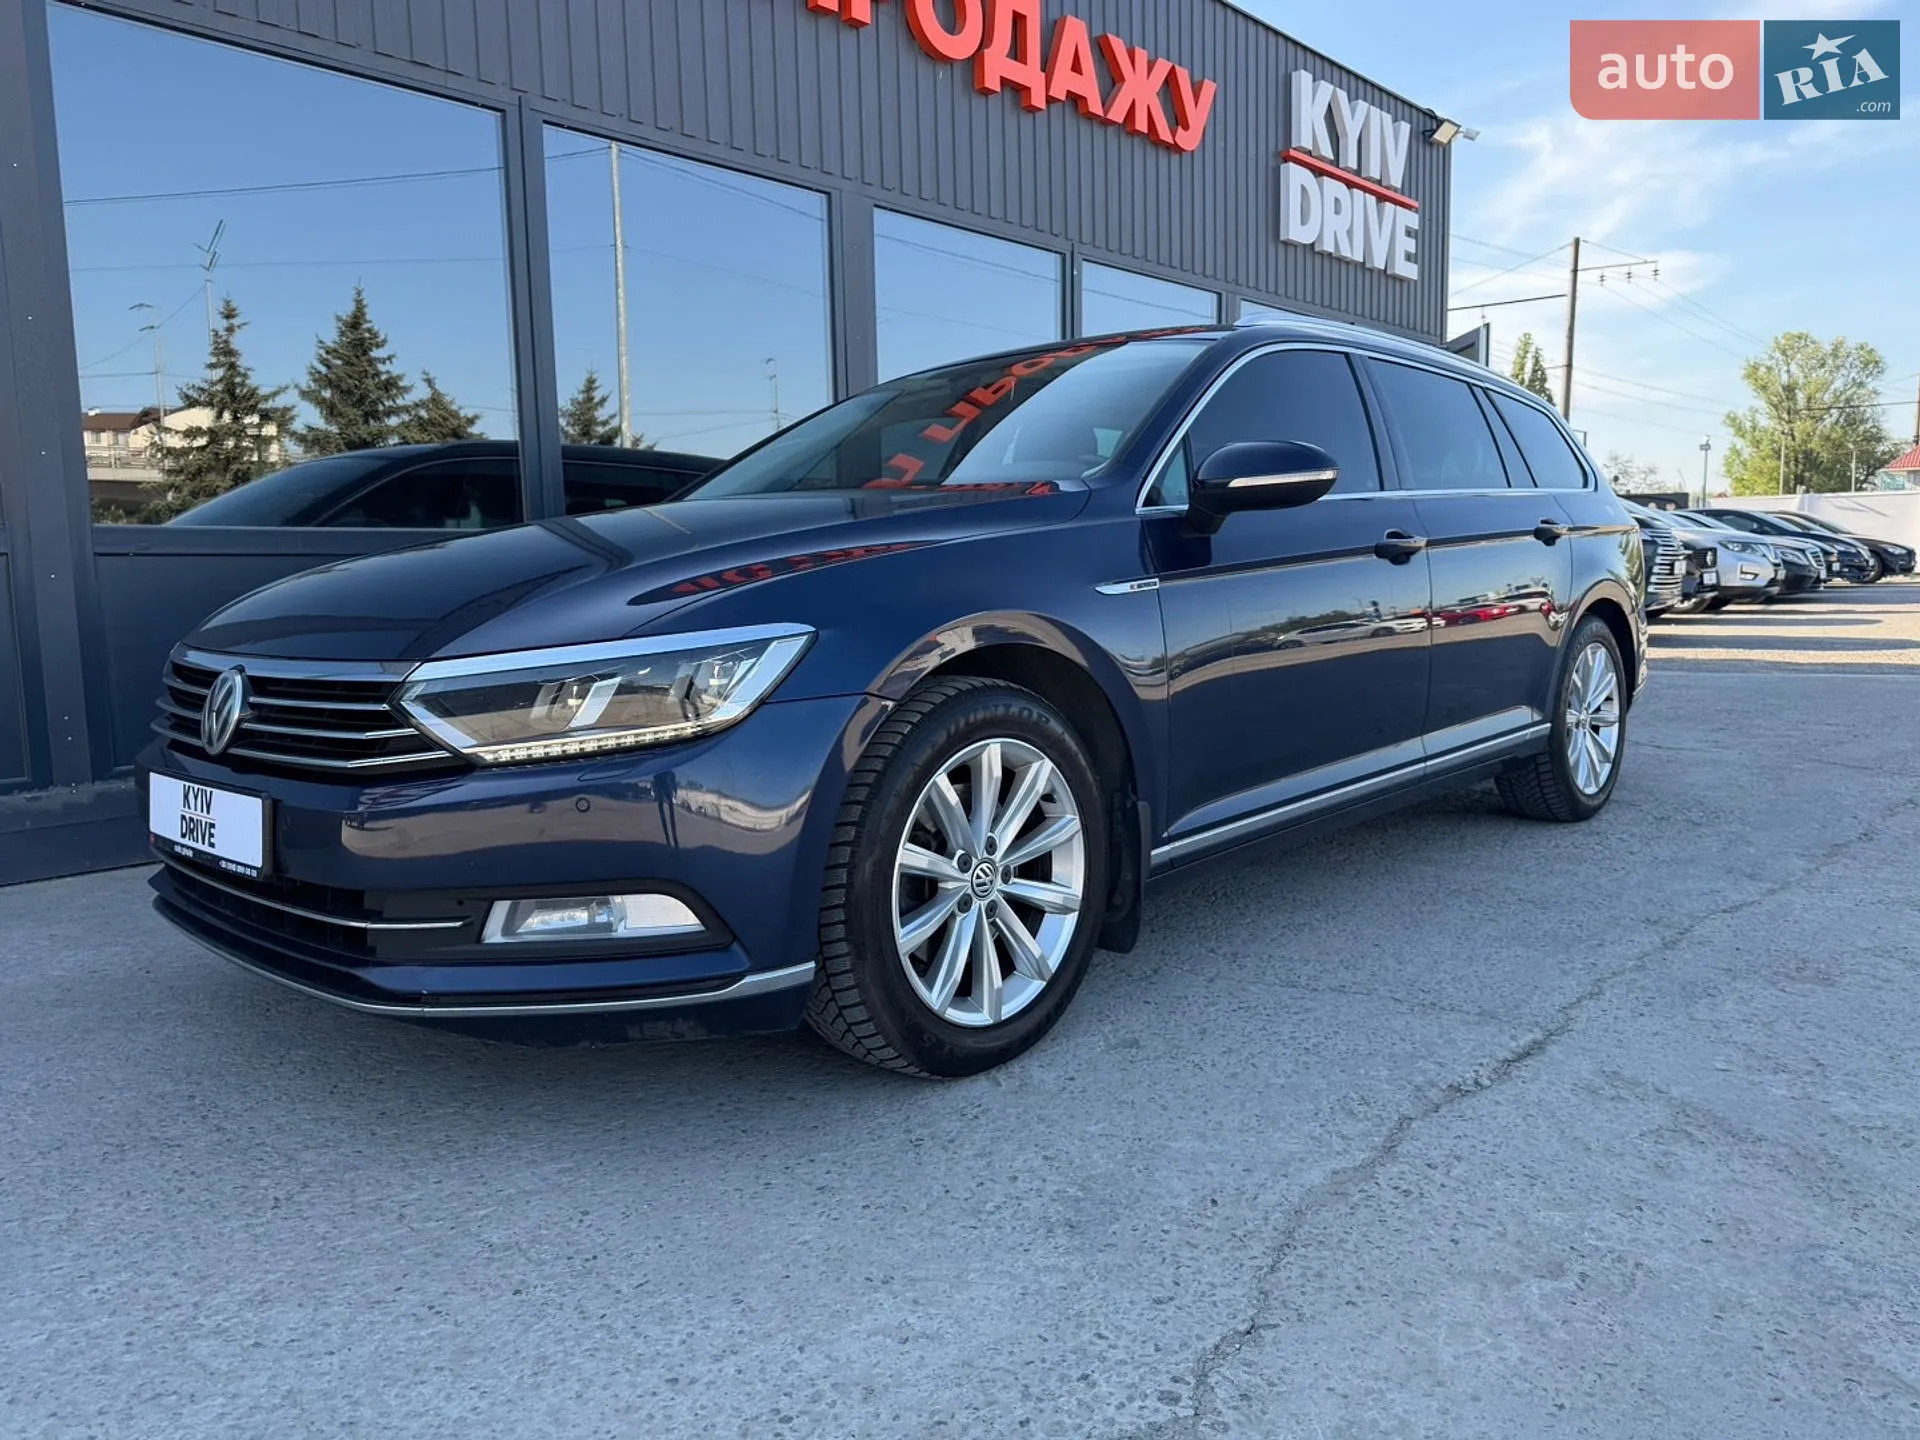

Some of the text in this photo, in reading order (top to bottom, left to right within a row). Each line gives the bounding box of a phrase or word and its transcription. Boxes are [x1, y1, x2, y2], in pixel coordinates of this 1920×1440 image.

[808, 0, 1217, 153] ОДАЖУ
[1291, 69, 1411, 189] KYIV
[1280, 162, 1419, 280] DRIVE
[180, 813, 216, 849] DRIVE
[182, 783, 214, 816] KYIV
